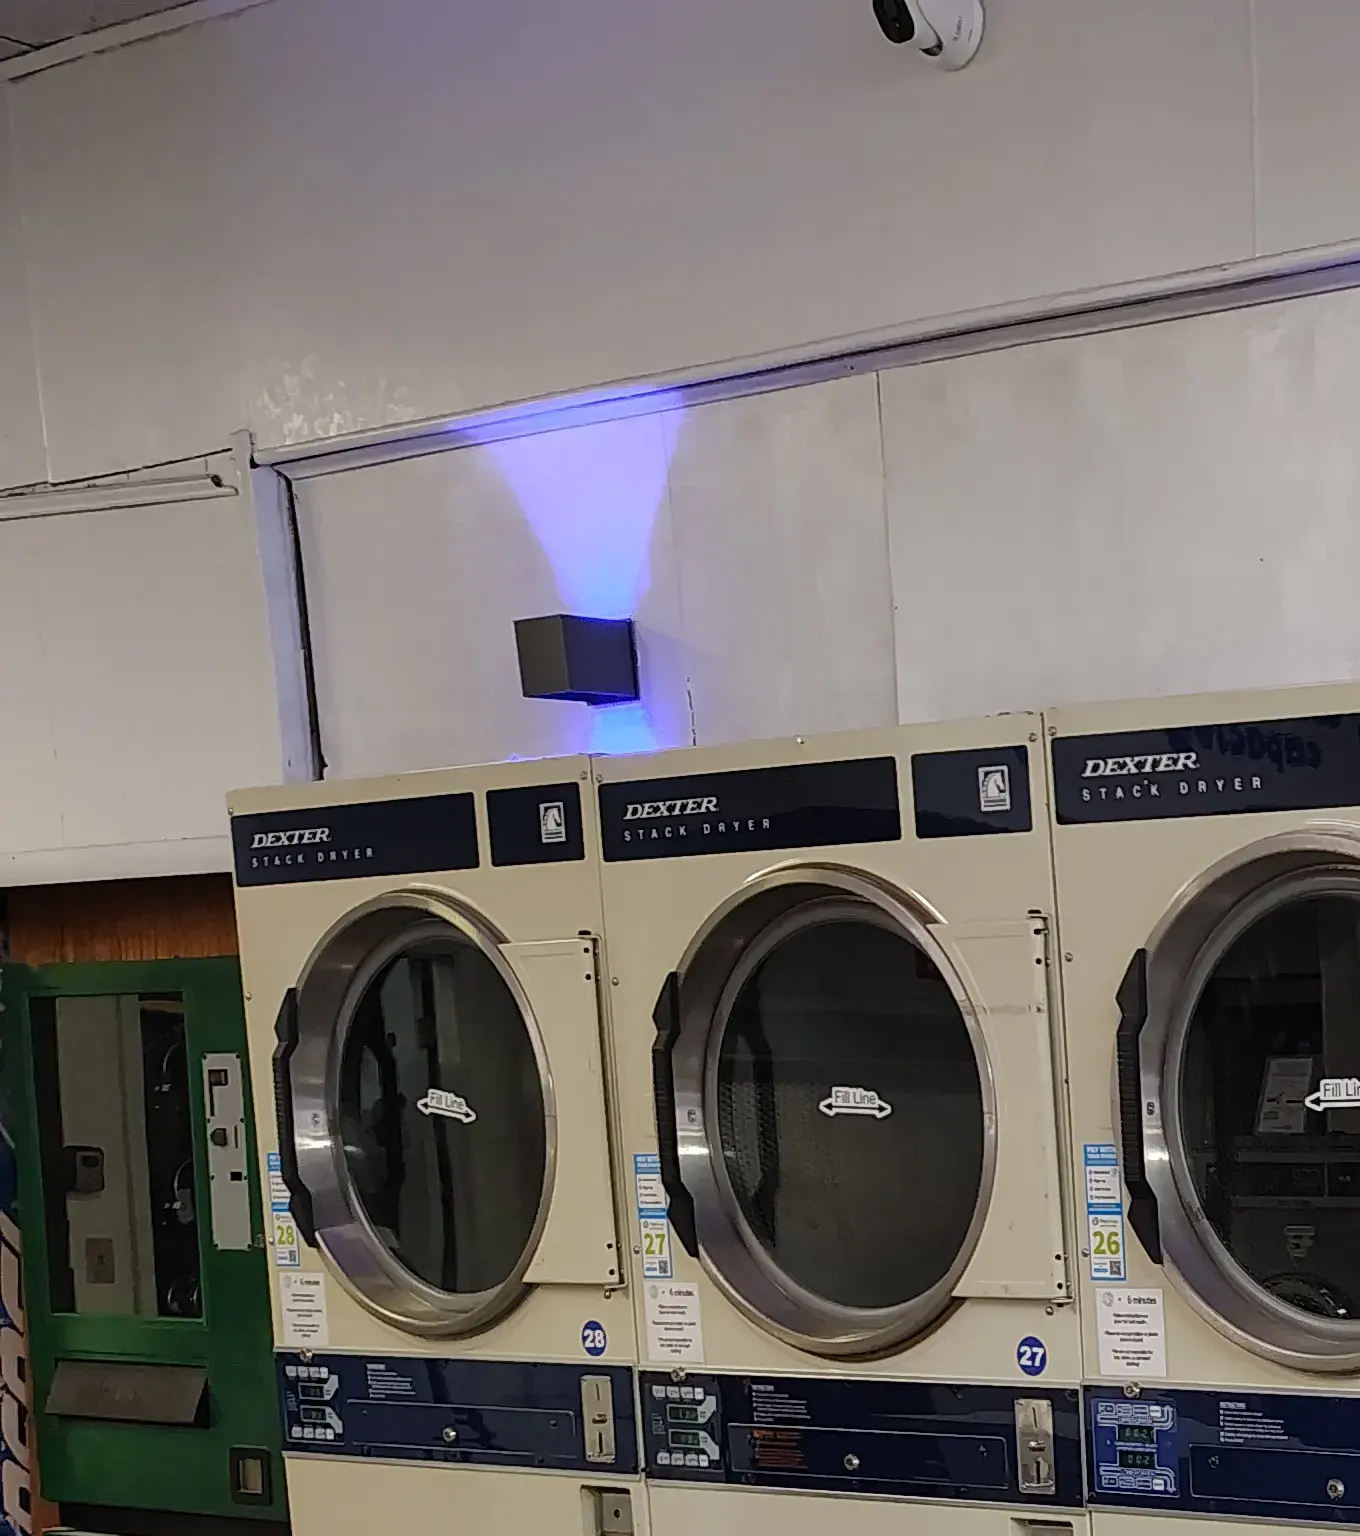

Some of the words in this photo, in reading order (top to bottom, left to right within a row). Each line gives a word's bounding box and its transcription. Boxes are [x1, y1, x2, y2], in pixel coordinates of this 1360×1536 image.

[1081, 752, 1199, 778] DEXTER
[1082, 781, 1161, 803] STACK
[1179, 776, 1263, 795] DRYER
[623, 796, 719, 821] DEXTER
[251, 827, 331, 848] DEXTER
[623, 825, 687, 842] STACK
[703, 818, 771, 835] DRYER
[251, 854, 305, 868] STACK
[317, 846, 375, 863] DRYER
[429, 1091, 444, 1106] Fill
[445, 1094, 465, 1111] Line
[834, 1091, 851, 1105] Fill
[852, 1091, 877, 1106] Line
[1323, 1082, 1341, 1098] Fill
[276, 1224, 295, 1246] 28
[643, 1233, 666, 1256] 27
[1093, 1230, 1121, 1256] 26
[583, 1330, 605, 1348] 28
[1019, 1345, 1045, 1367] 27
